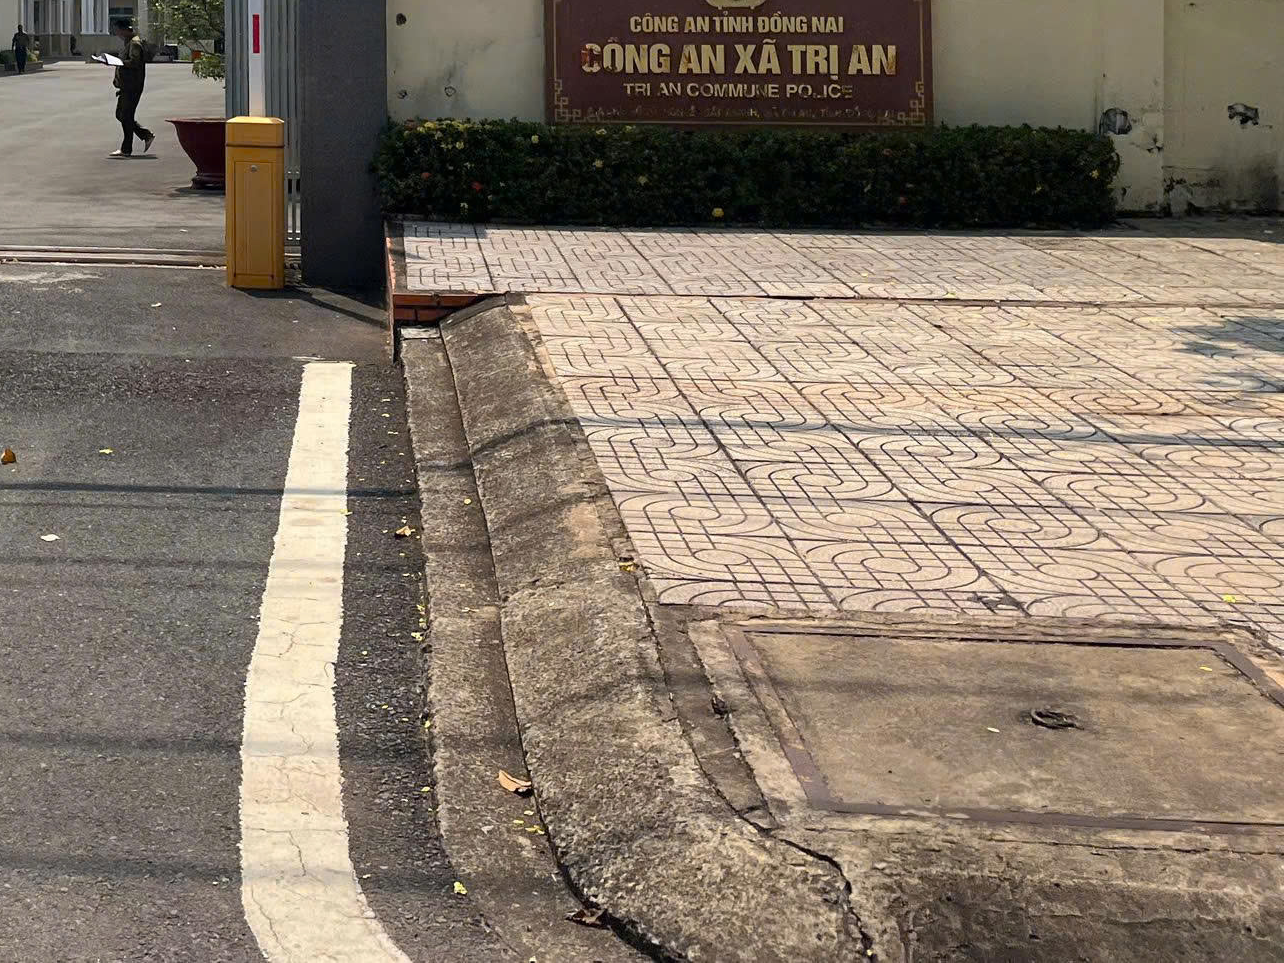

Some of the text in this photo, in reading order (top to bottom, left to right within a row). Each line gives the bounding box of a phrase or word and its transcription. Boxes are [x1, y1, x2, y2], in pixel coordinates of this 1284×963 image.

[630, 10, 844, 33] CÔNG AN TỈNH ĐỒNG NAI
[581, 37, 897, 80] CÔNG AN XÃ TRỊ AN
[623, 82, 651, 97] TRI
[657, 82, 681, 97] AN
[687, 83, 780, 98] COMMUNE
